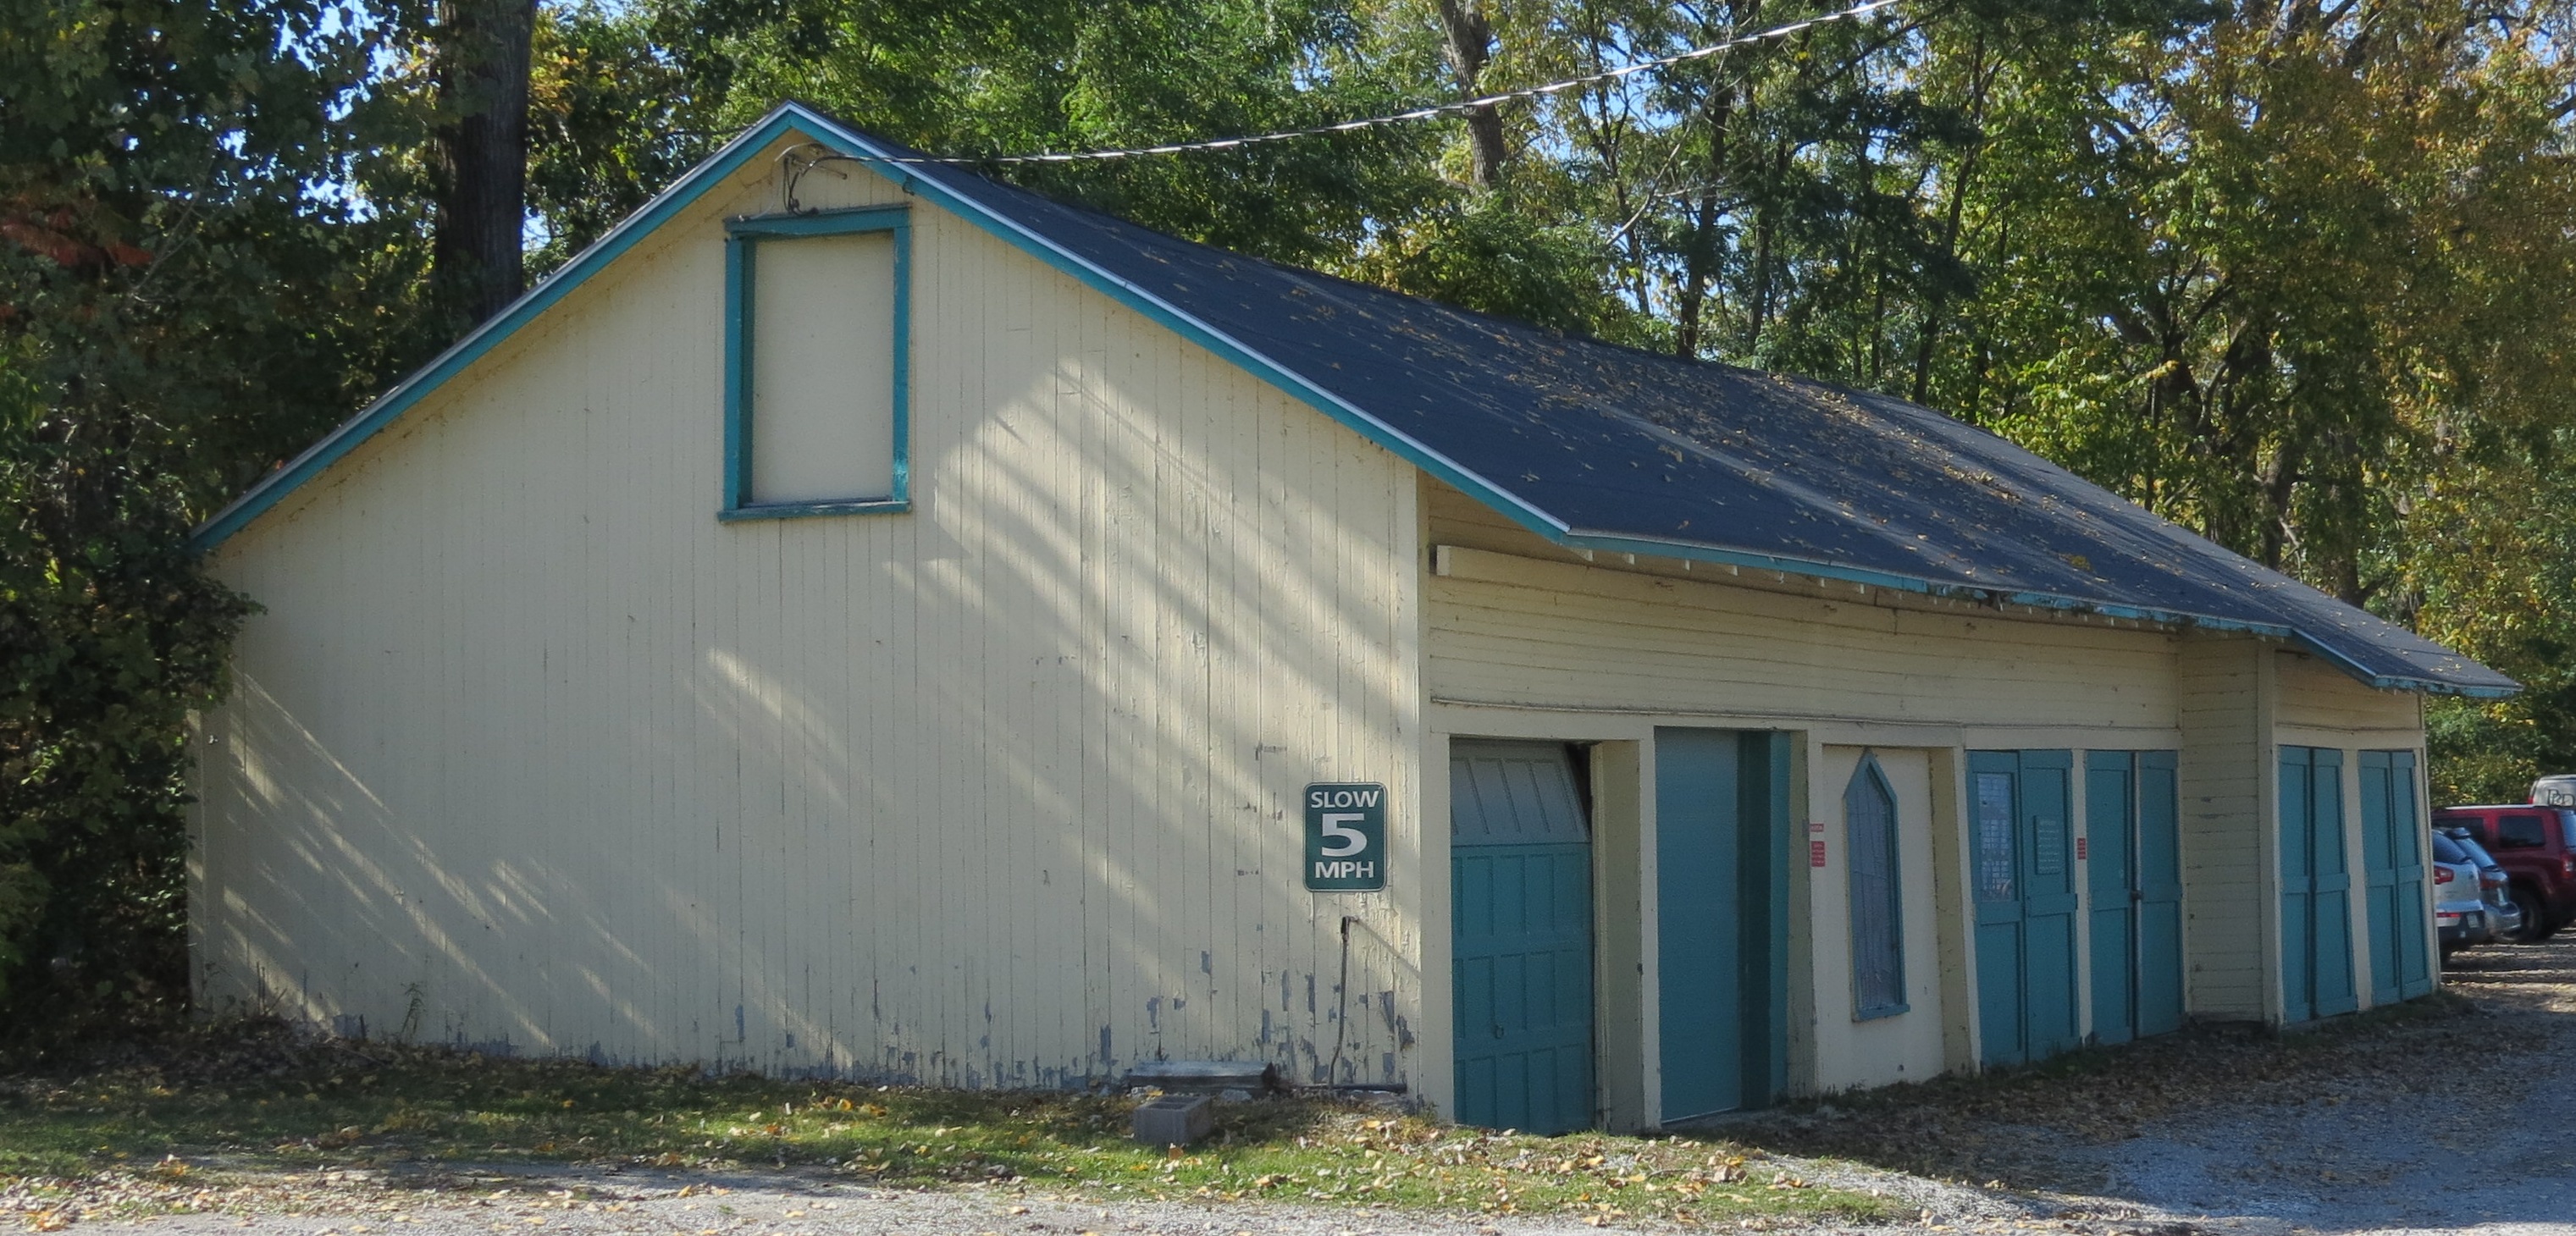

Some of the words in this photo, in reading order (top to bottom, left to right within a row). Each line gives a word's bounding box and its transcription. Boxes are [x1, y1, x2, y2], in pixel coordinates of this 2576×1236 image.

[1311, 791, 1379, 808] SLOW
[1321, 813, 1368, 857] 5
[1314, 861, 1374, 879] MPH
